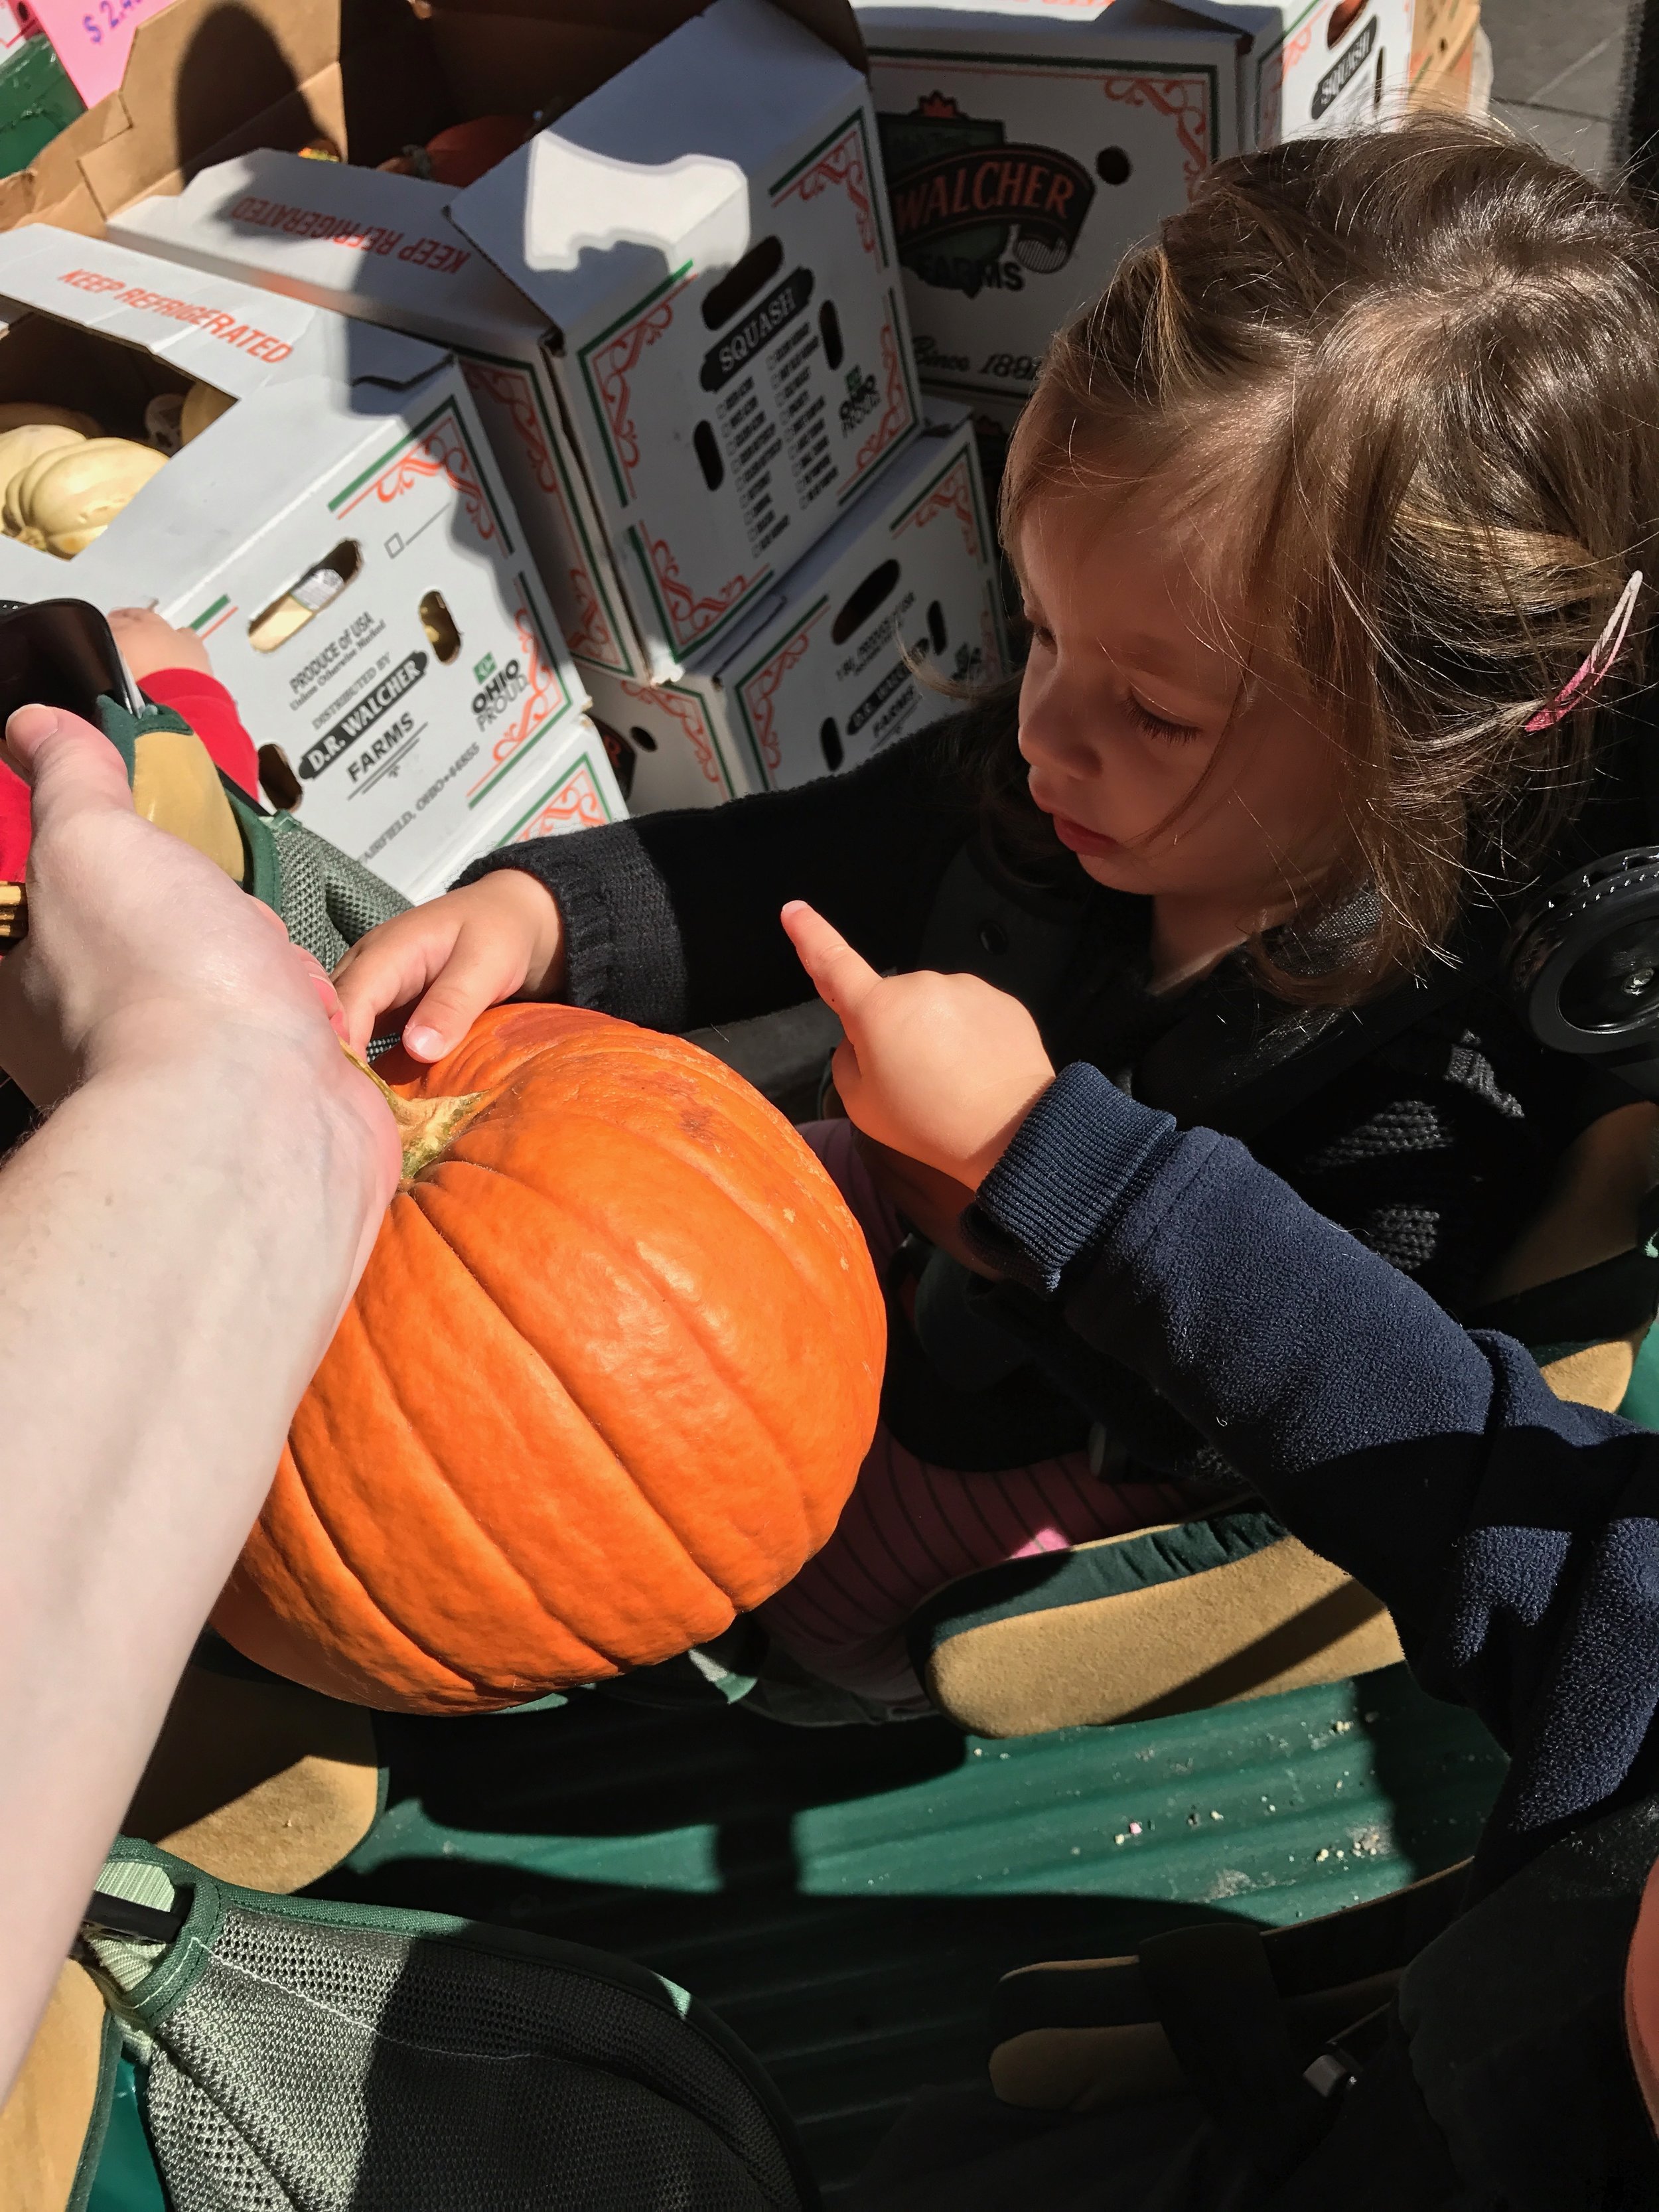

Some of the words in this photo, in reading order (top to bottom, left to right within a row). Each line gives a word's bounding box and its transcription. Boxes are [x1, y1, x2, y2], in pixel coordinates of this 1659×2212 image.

[230, 197, 404, 256] REFRIGERATED
[893, 160, 1075, 234] WALCHER
[398, 237, 471, 274] KEEP
[918, 255, 1025, 291] FARMS
[58, 269, 127, 293] KEEP
[113, 287, 294, 364] REFRIGERATED
[719, 287, 796, 373] SQUASH
[289, 641, 340, 695] PRODUCE
[338, 627, 352, 651] of
[350, 611, 374, 638] USA
[472, 659, 520, 714] OHIO
[307, 735, 346, 773] D.R.
[340, 660, 421, 737] WALCHER
[312, 666, 377, 730] DISTRIBUTED
[376, 651, 391, 671] BY
[475, 673, 529, 733] PROUD
[346, 711, 415, 783] FARMS
[359, 810, 417, 863] AIRFIELD,
